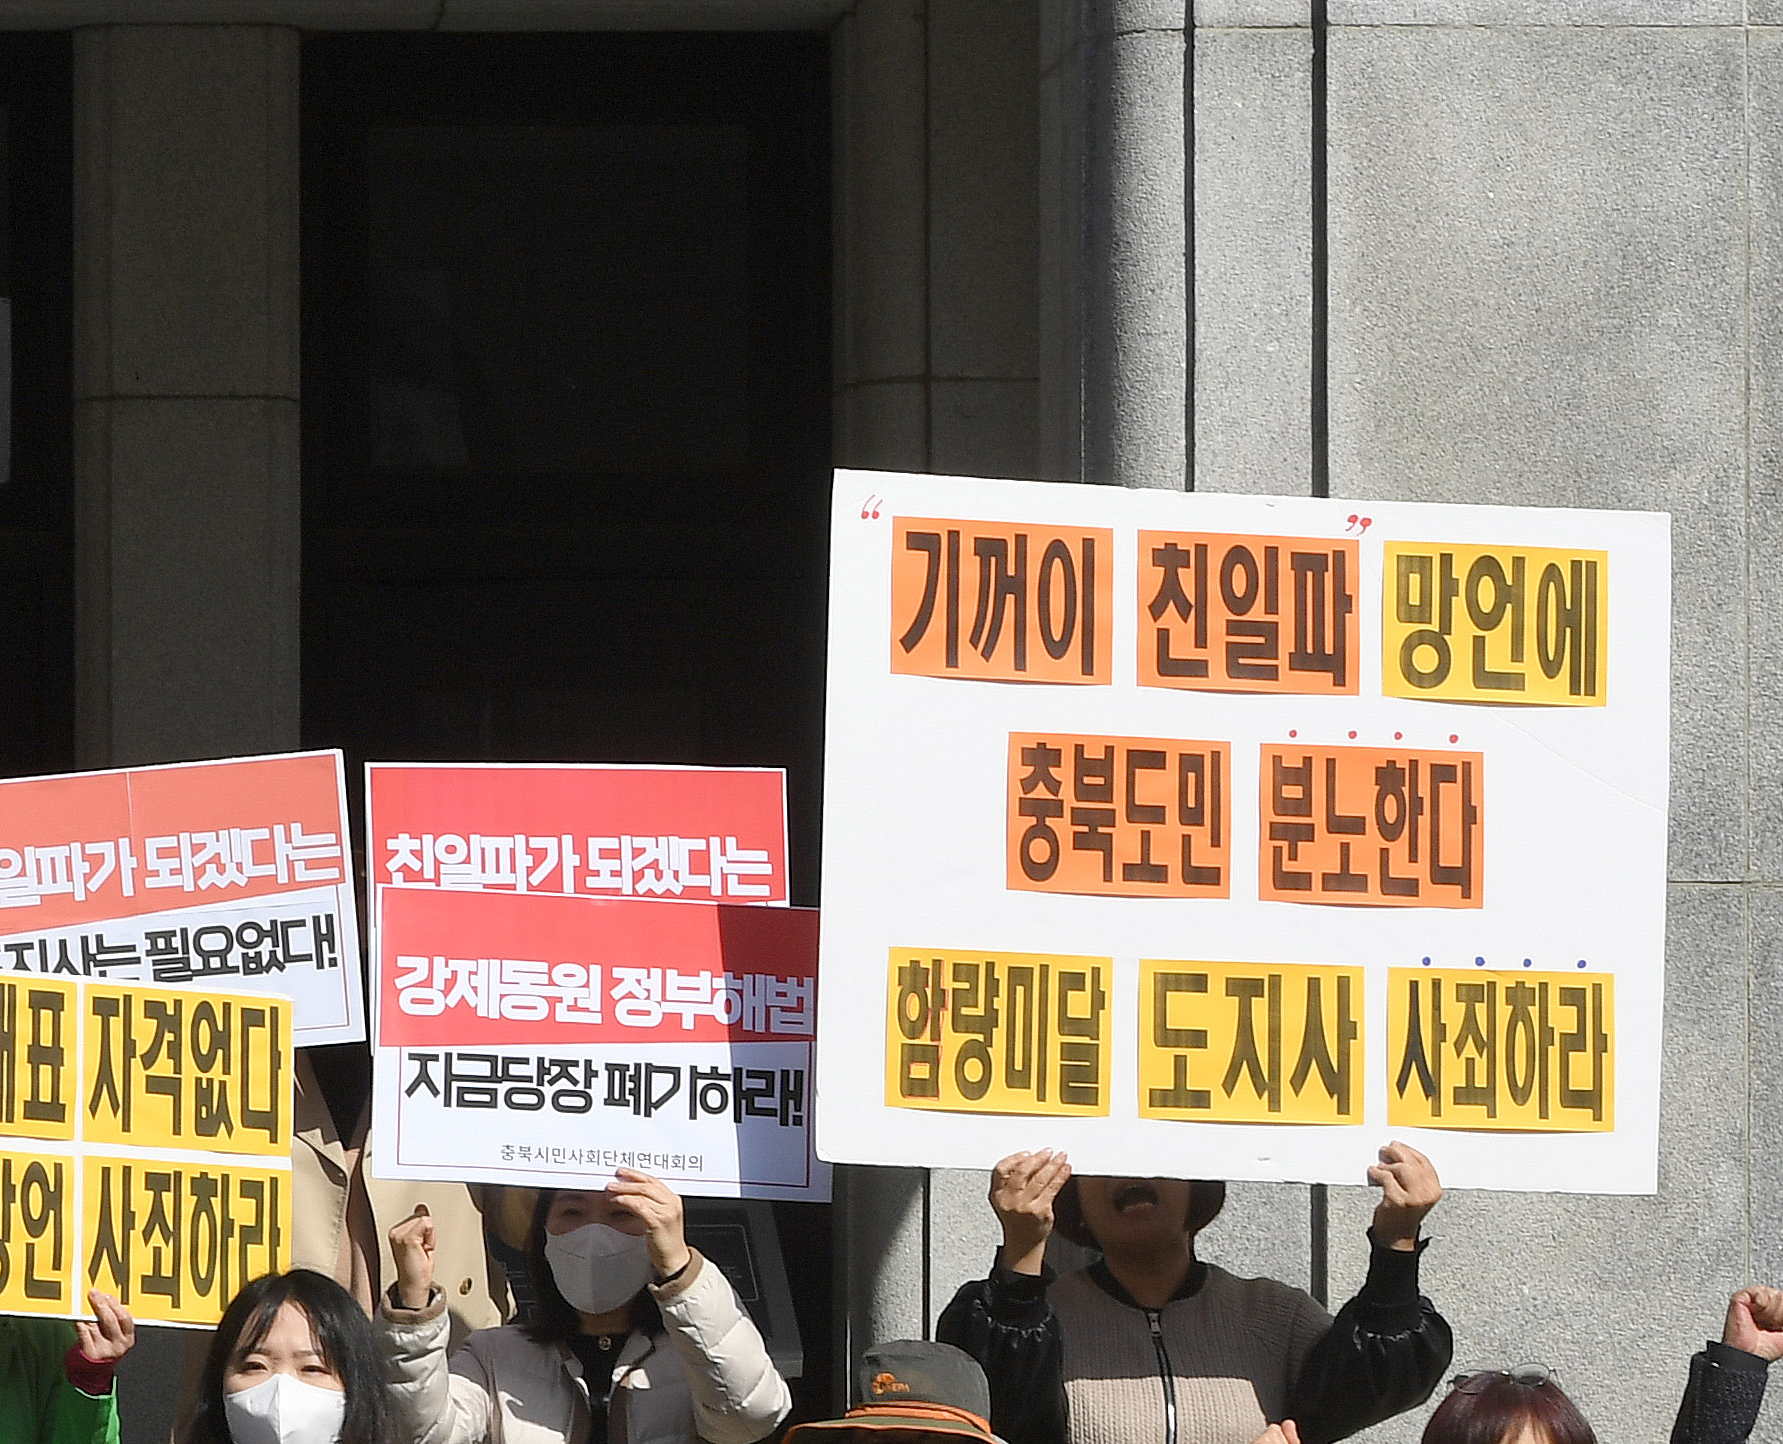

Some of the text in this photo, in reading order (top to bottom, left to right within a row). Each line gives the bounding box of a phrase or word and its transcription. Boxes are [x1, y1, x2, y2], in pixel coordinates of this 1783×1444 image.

[1395, 553, 1598, 697] 망언에
[144, 823, 342, 892] 되겠다는
[1018, 742, 1477, 901] 충북도민 분노한다
[386, 833, 774, 897] 친일파가 되겠다는
[144, 914, 338, 983] 필요없다!
[394, 956, 815, 1035] 강제동원 정부해법
[88, 993, 283, 1145] 자격없다
[897, 957, 1608, 1123] 함량미달 도지사 사죄하라
[405, 1052, 805, 1127] 지금당장 폐기하라!
[500, 1144, 704, 1173] 충북시민사회단체연대회의
[88, 1165, 281, 1312] 사죄하라
